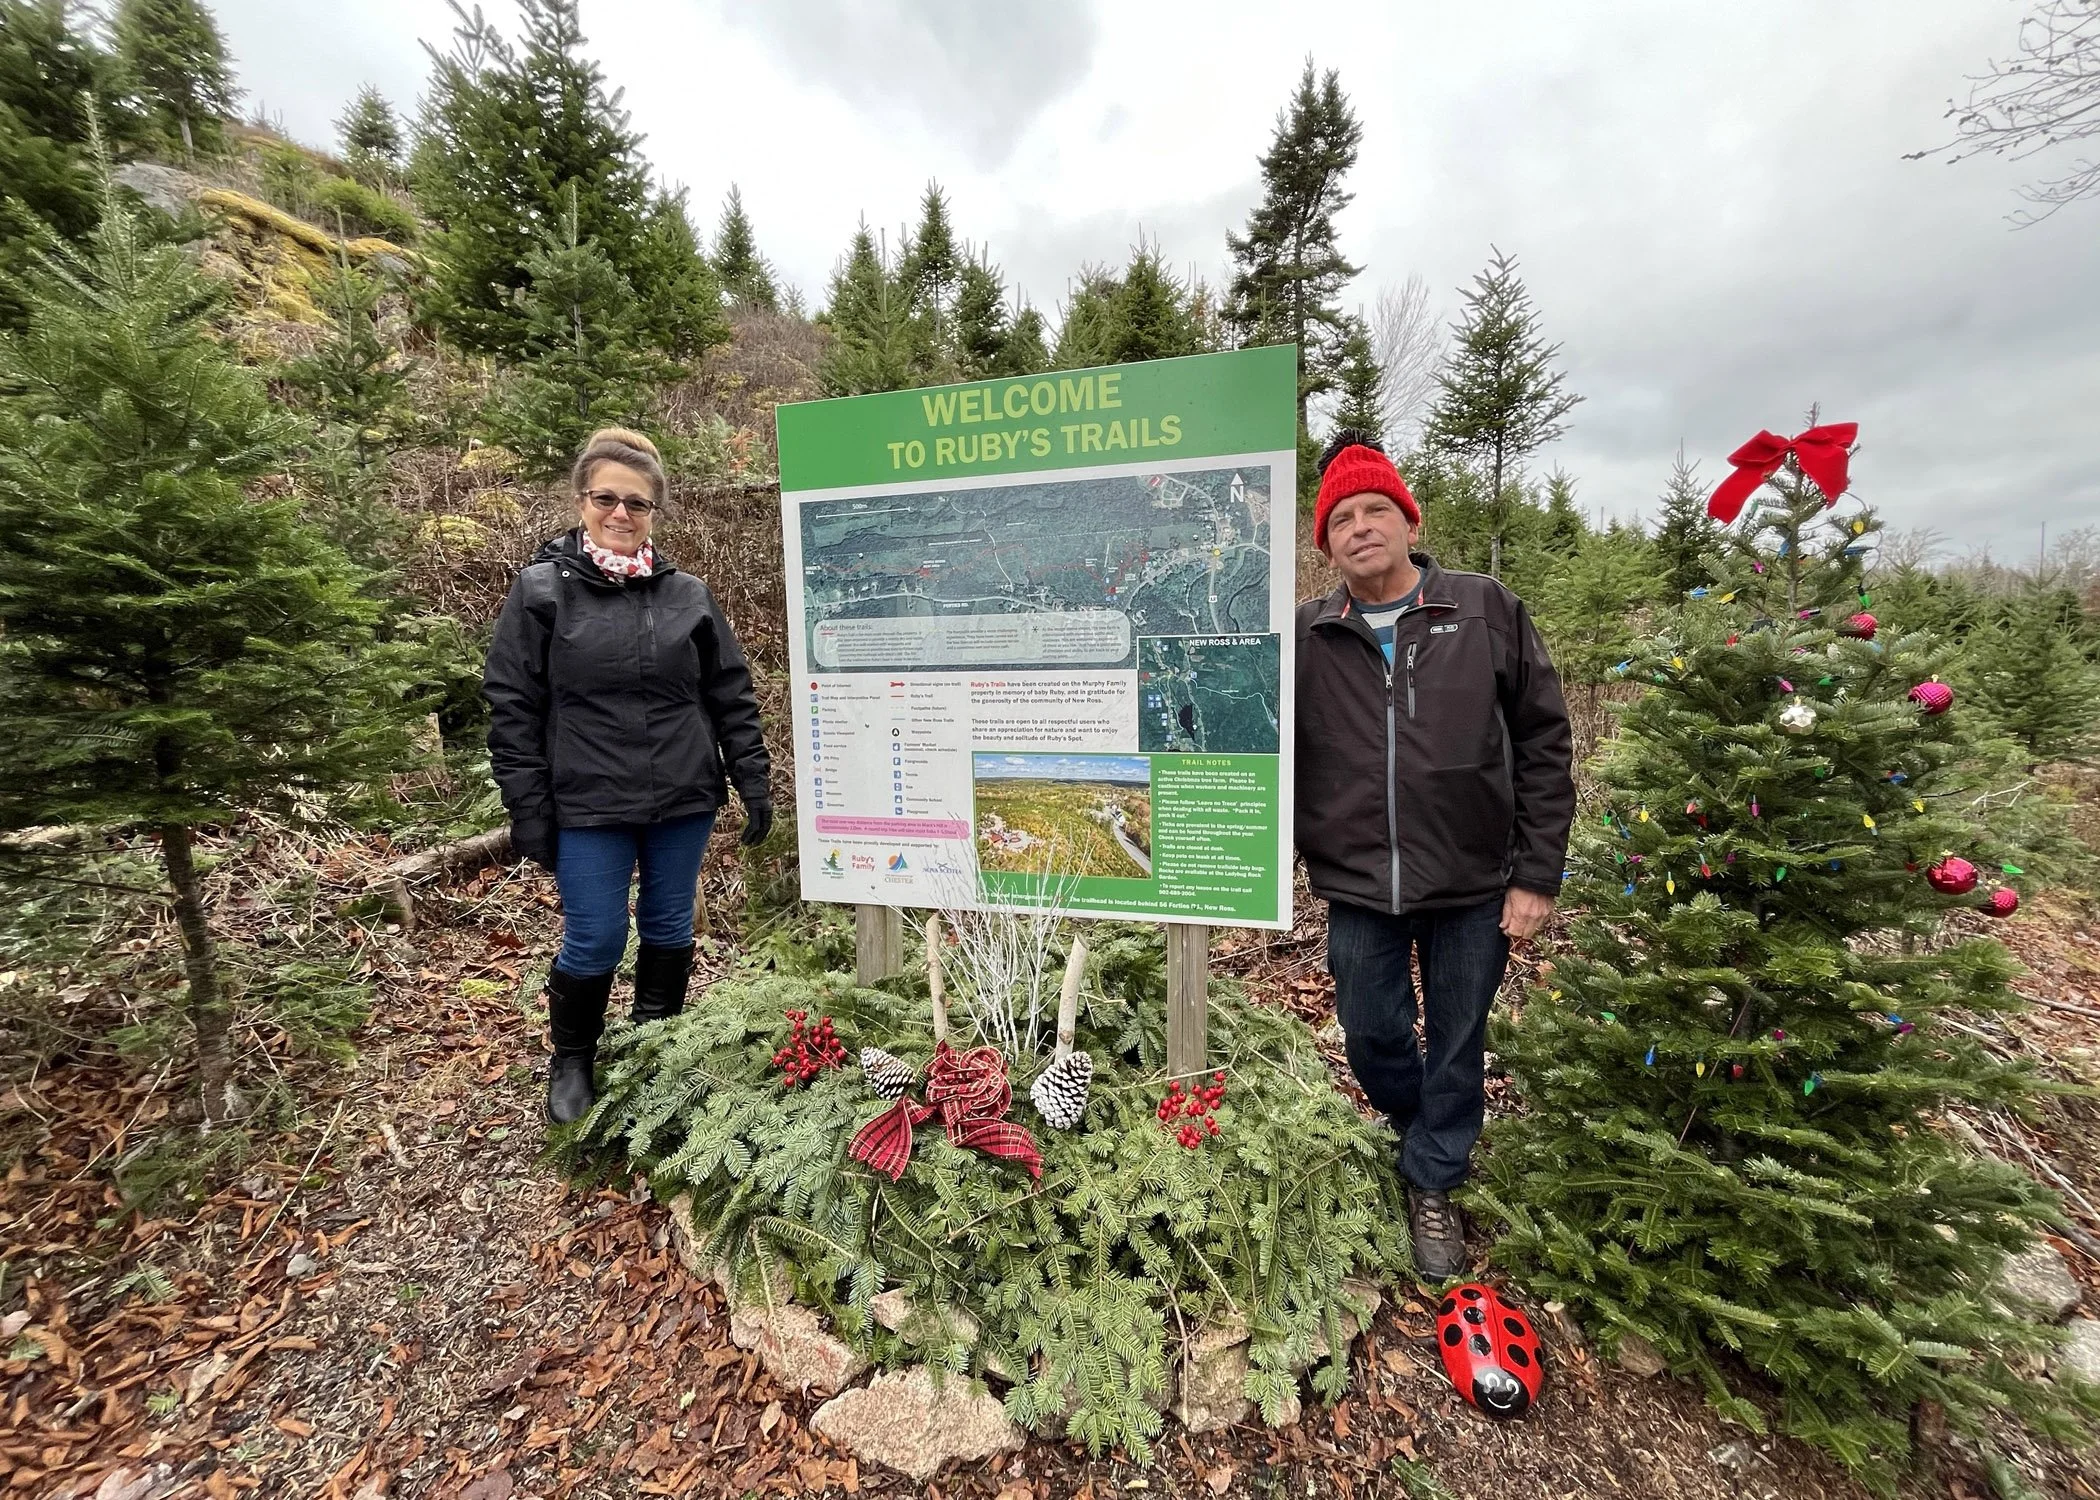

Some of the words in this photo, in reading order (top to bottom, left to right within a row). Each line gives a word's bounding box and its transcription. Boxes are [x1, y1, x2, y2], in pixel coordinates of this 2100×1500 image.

[922, 373, 1122, 426] WELCOME
[887, 440, 926, 469] TO
[936, 428, 1051, 465] RUBY'S
[1061, 415, 1182, 454] TRAILS
[1230, 486, 1244, 503] N
[852, 855, 874, 863] Ruby's
[852, 863, 875, 871] Family
